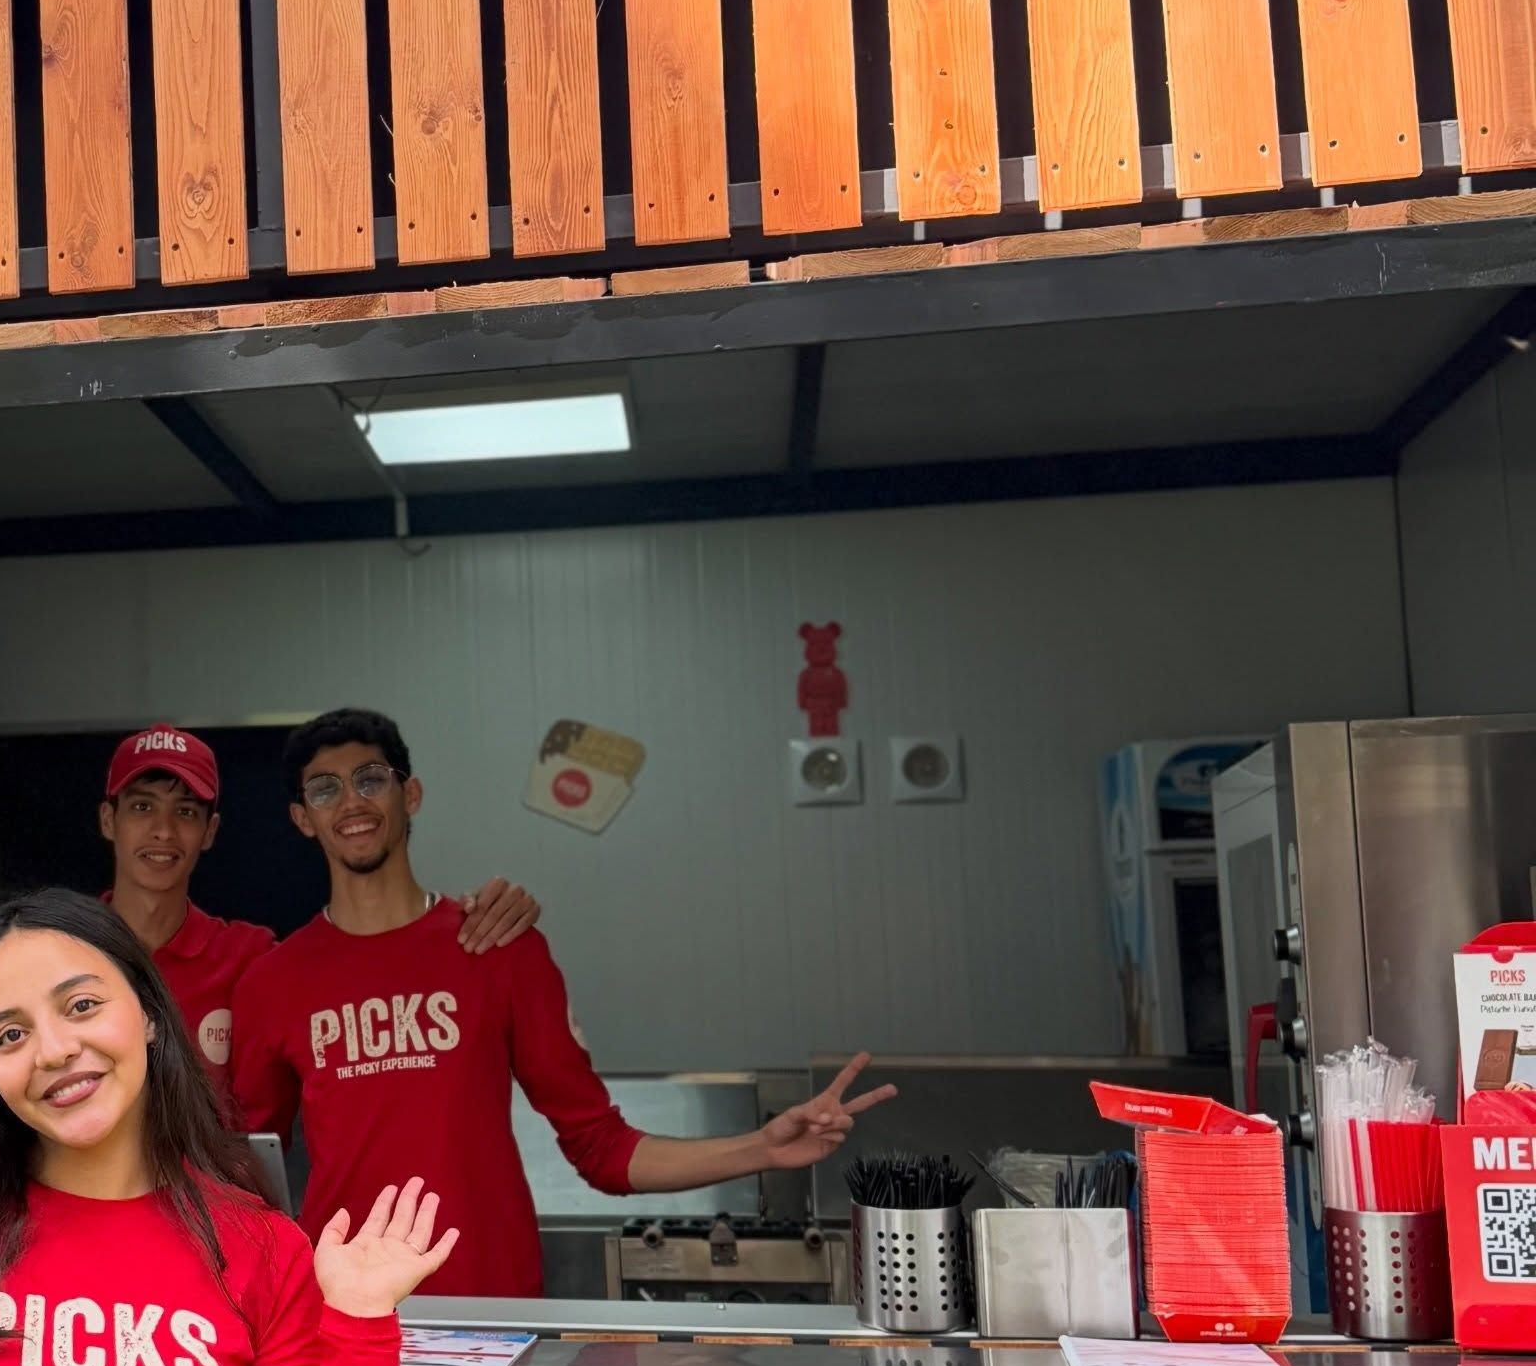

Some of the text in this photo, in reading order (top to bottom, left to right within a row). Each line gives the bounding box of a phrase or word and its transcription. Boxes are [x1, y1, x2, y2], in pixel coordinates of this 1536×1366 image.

[134, 731, 188, 755] PICKS
[1490, 969, 1526, 983] PICKS
[1481, 992, 1521, 1002] CHOCOLATE
[207, 1027, 232, 1043] PICK
[311, 991, 460, 1069] PICKS
[336, 1055, 436, 1080] THE PICKY EXPERIENCE
[1472, 1137, 1536, 1171] ME
